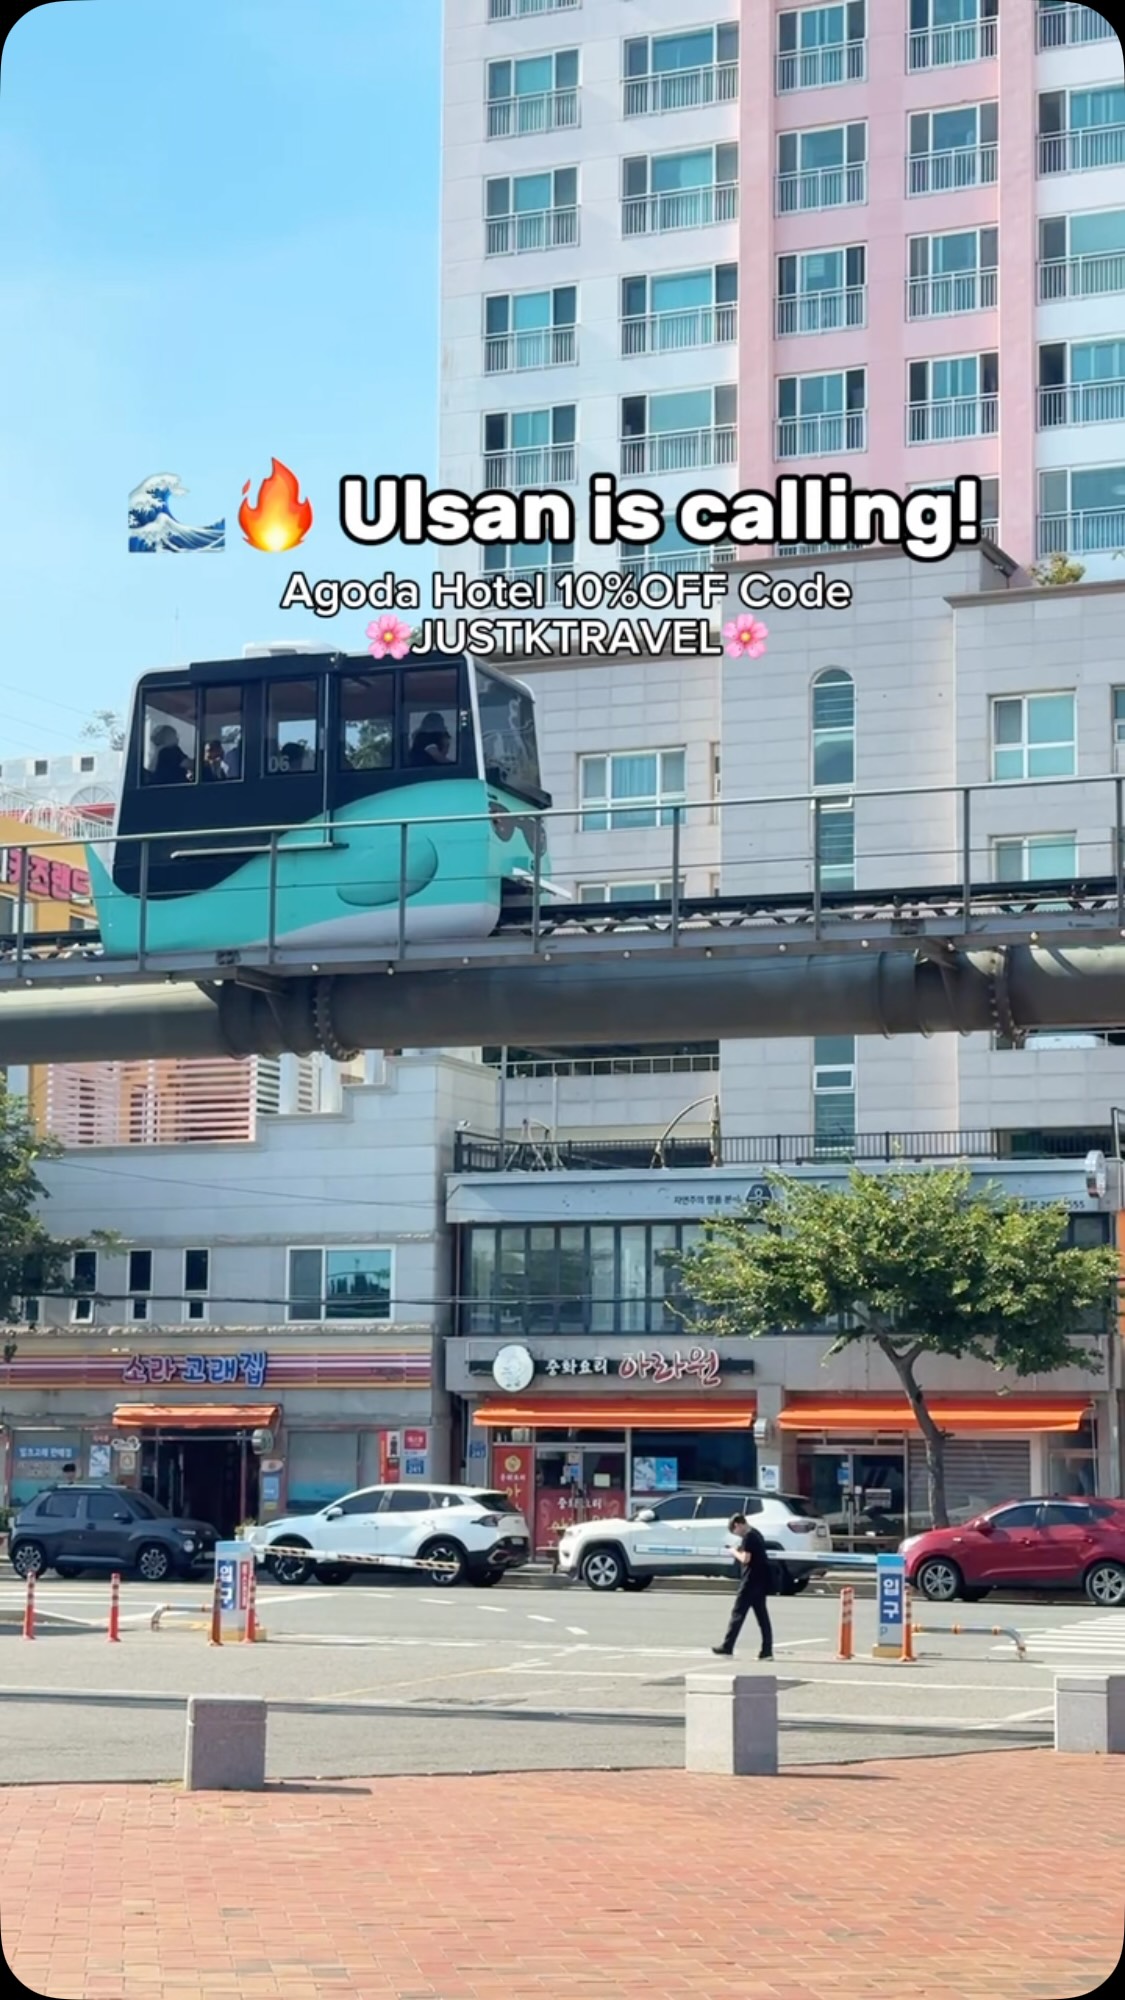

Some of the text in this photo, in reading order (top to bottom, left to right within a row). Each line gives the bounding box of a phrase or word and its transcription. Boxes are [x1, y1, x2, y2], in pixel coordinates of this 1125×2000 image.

[269, 755, 290, 773] 06
[123, 1352, 267, 1388] 소라 고래집
[545, 1346, 722, 1388] 중화요리 아라원
[883, 1578, 900, 1619] 입구
